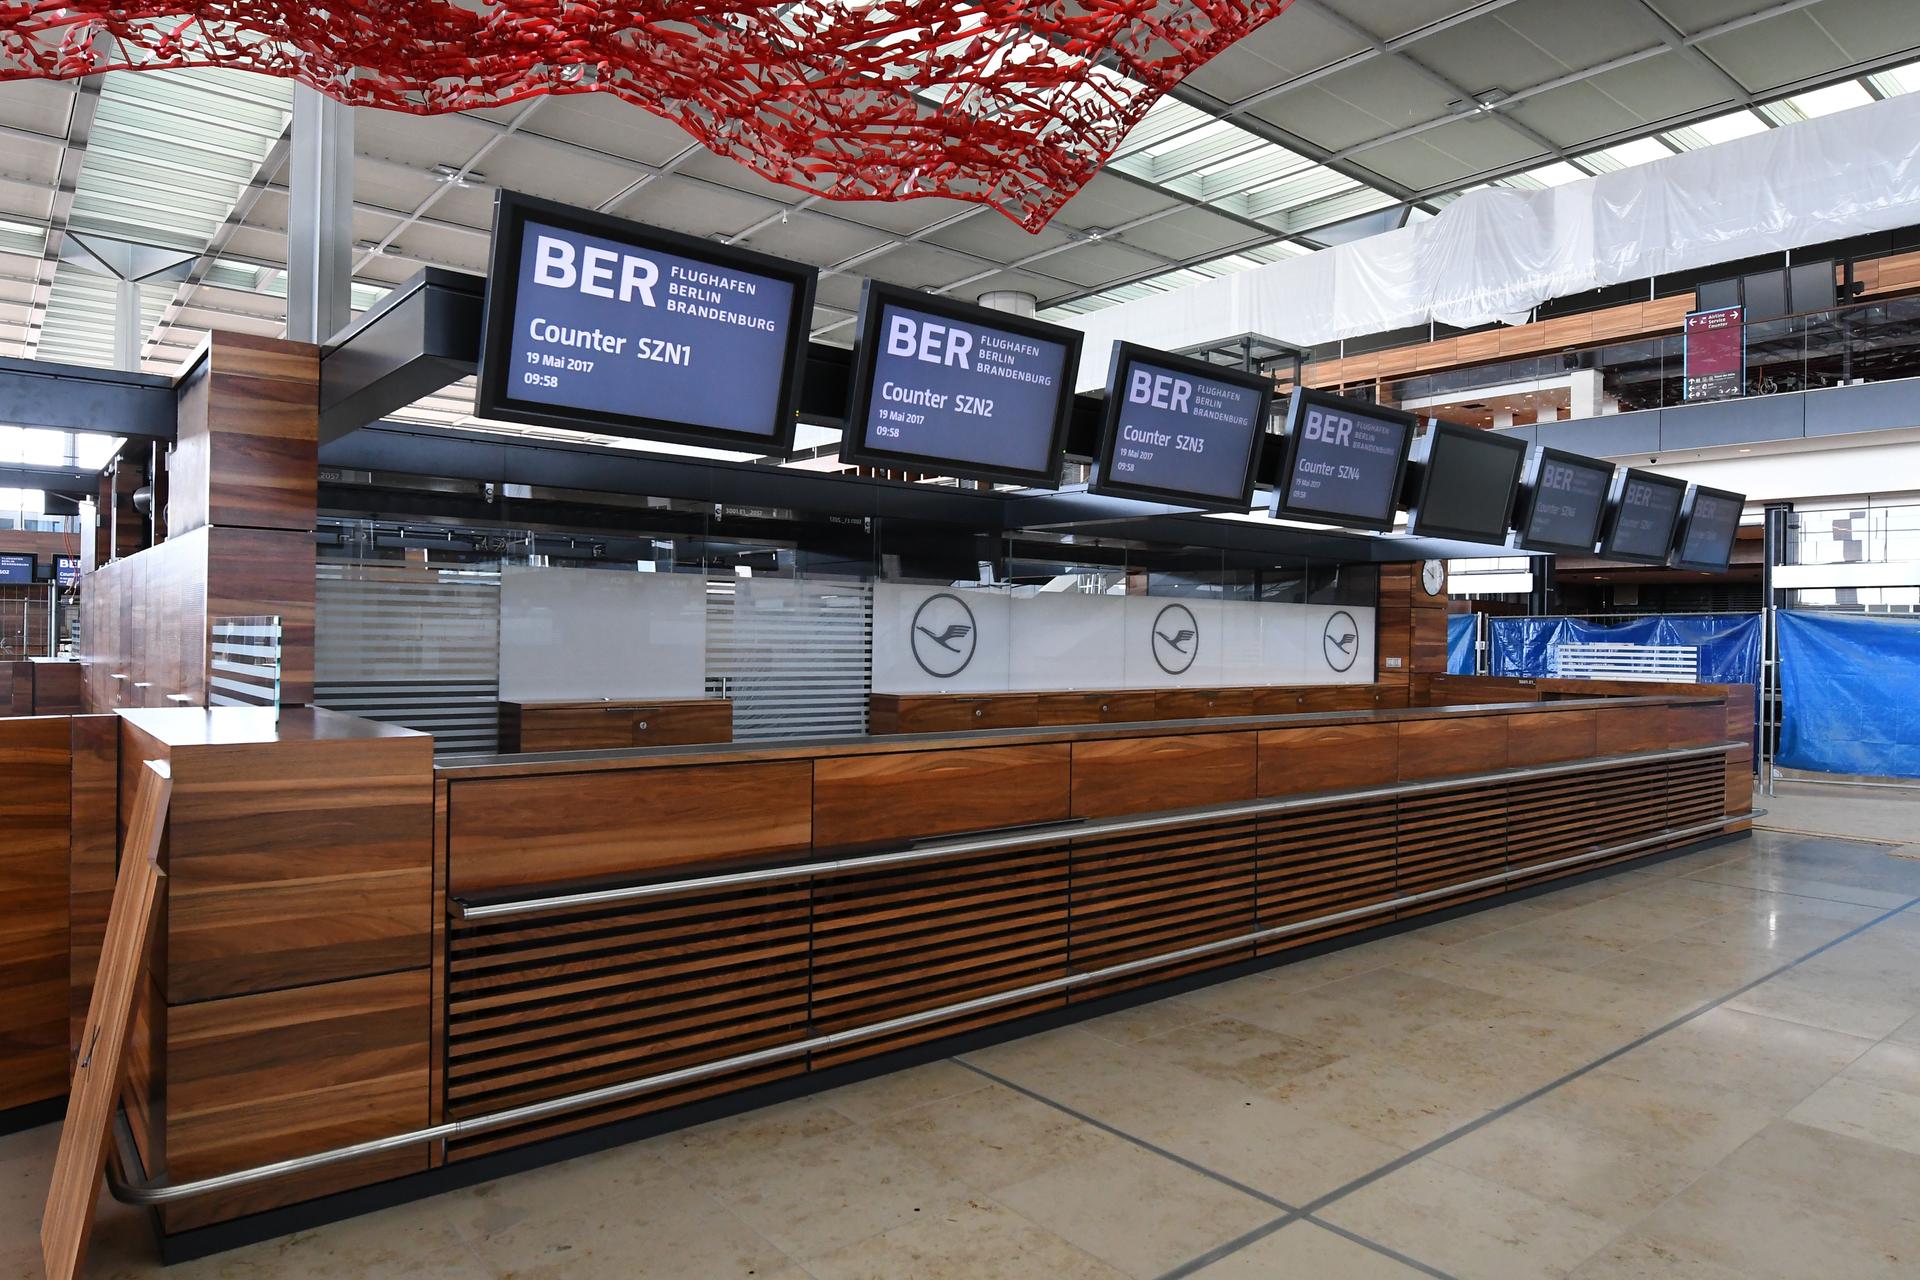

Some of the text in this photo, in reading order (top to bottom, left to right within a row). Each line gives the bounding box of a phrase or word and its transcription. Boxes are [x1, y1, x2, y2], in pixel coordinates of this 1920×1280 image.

[533, 236, 659, 308] BER
[671, 266, 756, 295] FLUGHAFEN
[669, 283, 721, 304] BERLIN
[667, 299, 775, 332] BRANDENBURG
[529, 318, 691, 366] Counter SZN1
[887, 315, 973, 370] BER
[981, 335, 1040, 357] FLUGHAFEN
[526, 352, 594, 373] 19 Mai 2017
[979, 349, 1015, 365] BERLIN
[524, 372, 558, 388] 09:58
[977, 363, 1052, 386] BRANDENBURG
[882, 382, 994, 417] Counter SZN2
[1128, 369, 1192, 415] BER
[1195, 396, 1222, 409] BERLIN
[1197, 384, 1241, 402] FLUGHAFEN
[879, 409, 925, 425] 19 Mai 2017
[1193, 408, 1248, 426] BRANDENBURG
[876, 426, 900, 437] 09:58
[1123, 425, 1204, 454] Counter SZN3
[1304, 411, 1353, 447] BER
[1354, 431, 1375, 442] BERLIN
[1120, 448, 1154, 461] 19 Mai 2017
[1117, 462, 1135, 472] 09:58
[1299, 458, 1360, 480] Counter SZN4
[1544, 466, 1573, 490] BER
[1625, 484, 1652, 507] BER
